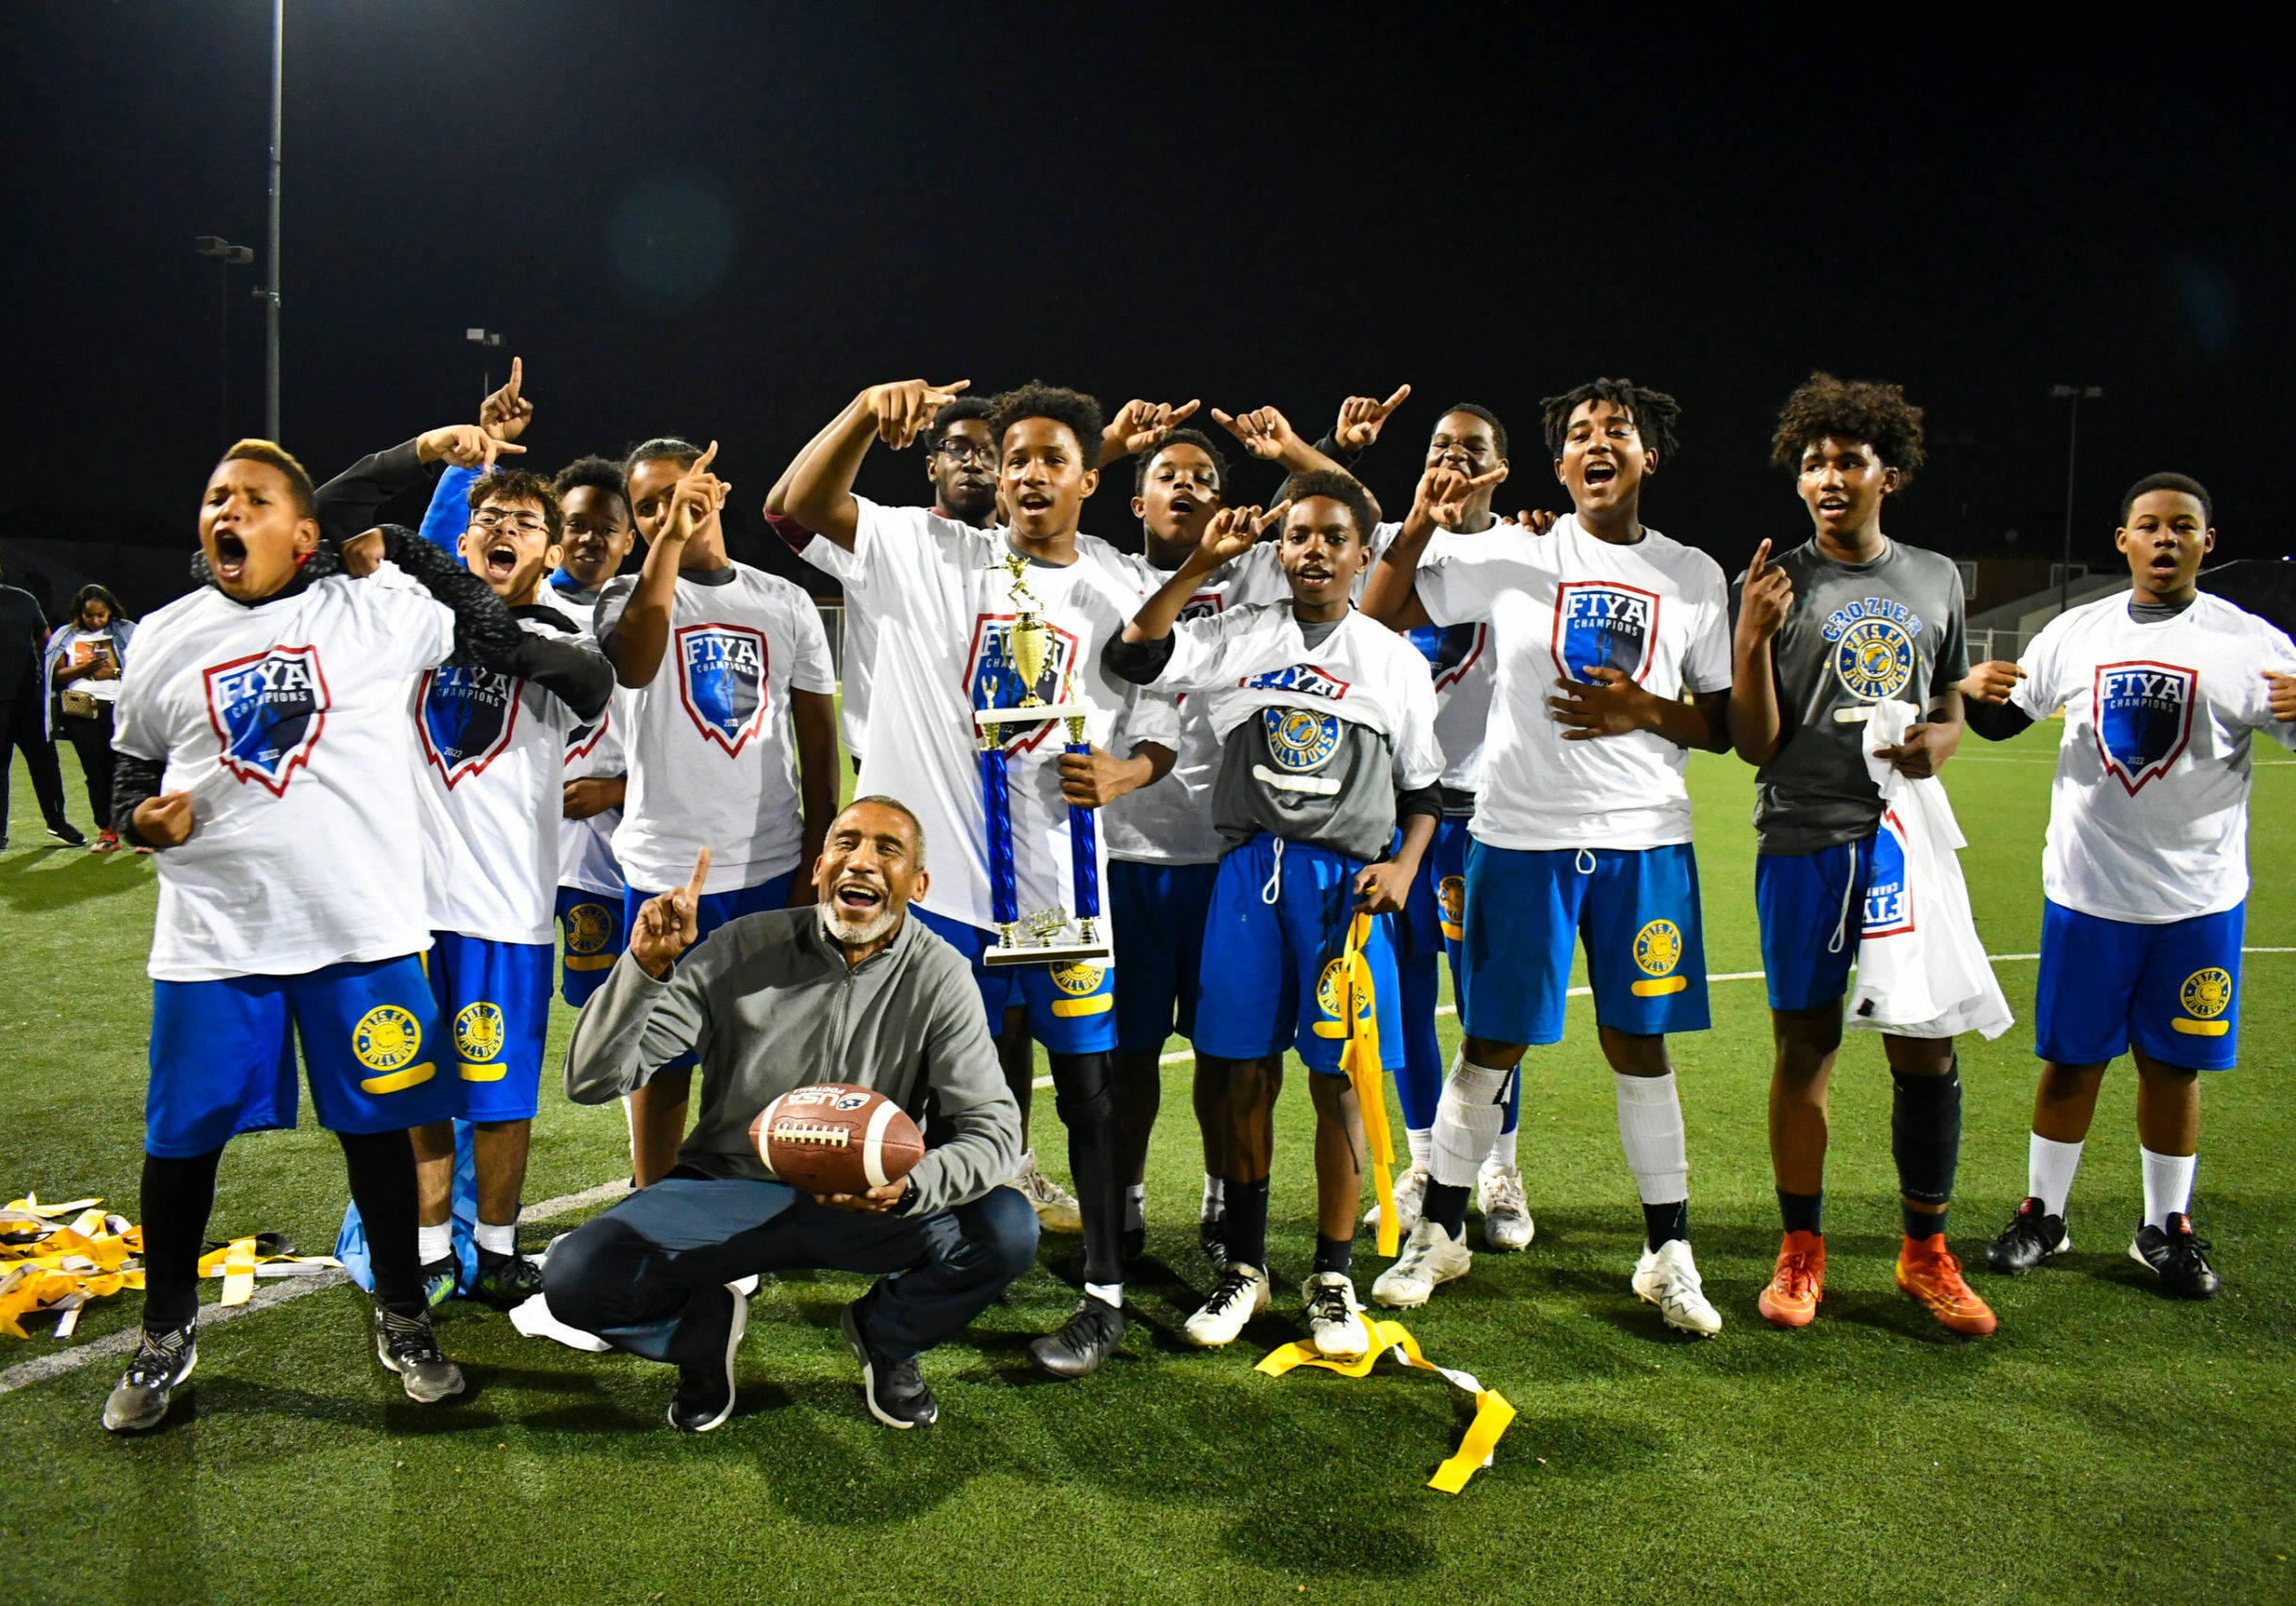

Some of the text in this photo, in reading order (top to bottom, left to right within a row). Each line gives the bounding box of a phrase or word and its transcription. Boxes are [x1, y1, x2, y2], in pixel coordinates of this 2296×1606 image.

[1565, 592, 1647, 629] FIYA
[1573, 618, 1638, 636] CHAMPIONS
[1821, 597, 1922, 642] CROZIER
[686, 636, 760, 668] FIYA
[217, 661, 314, 714] FIYA
[433, 665, 508, 701] FIYA
[1842, 663, 1908, 697] BULLDOGS
[2103, 673, 2184, 705] FIYA
[2110, 697, 2175, 713] CHAMPIONS
[443, 746, 464, 759] 2022
[1270, 731, 1335, 765] BULLDOGS
[788, 1092, 840, 1106] USA
